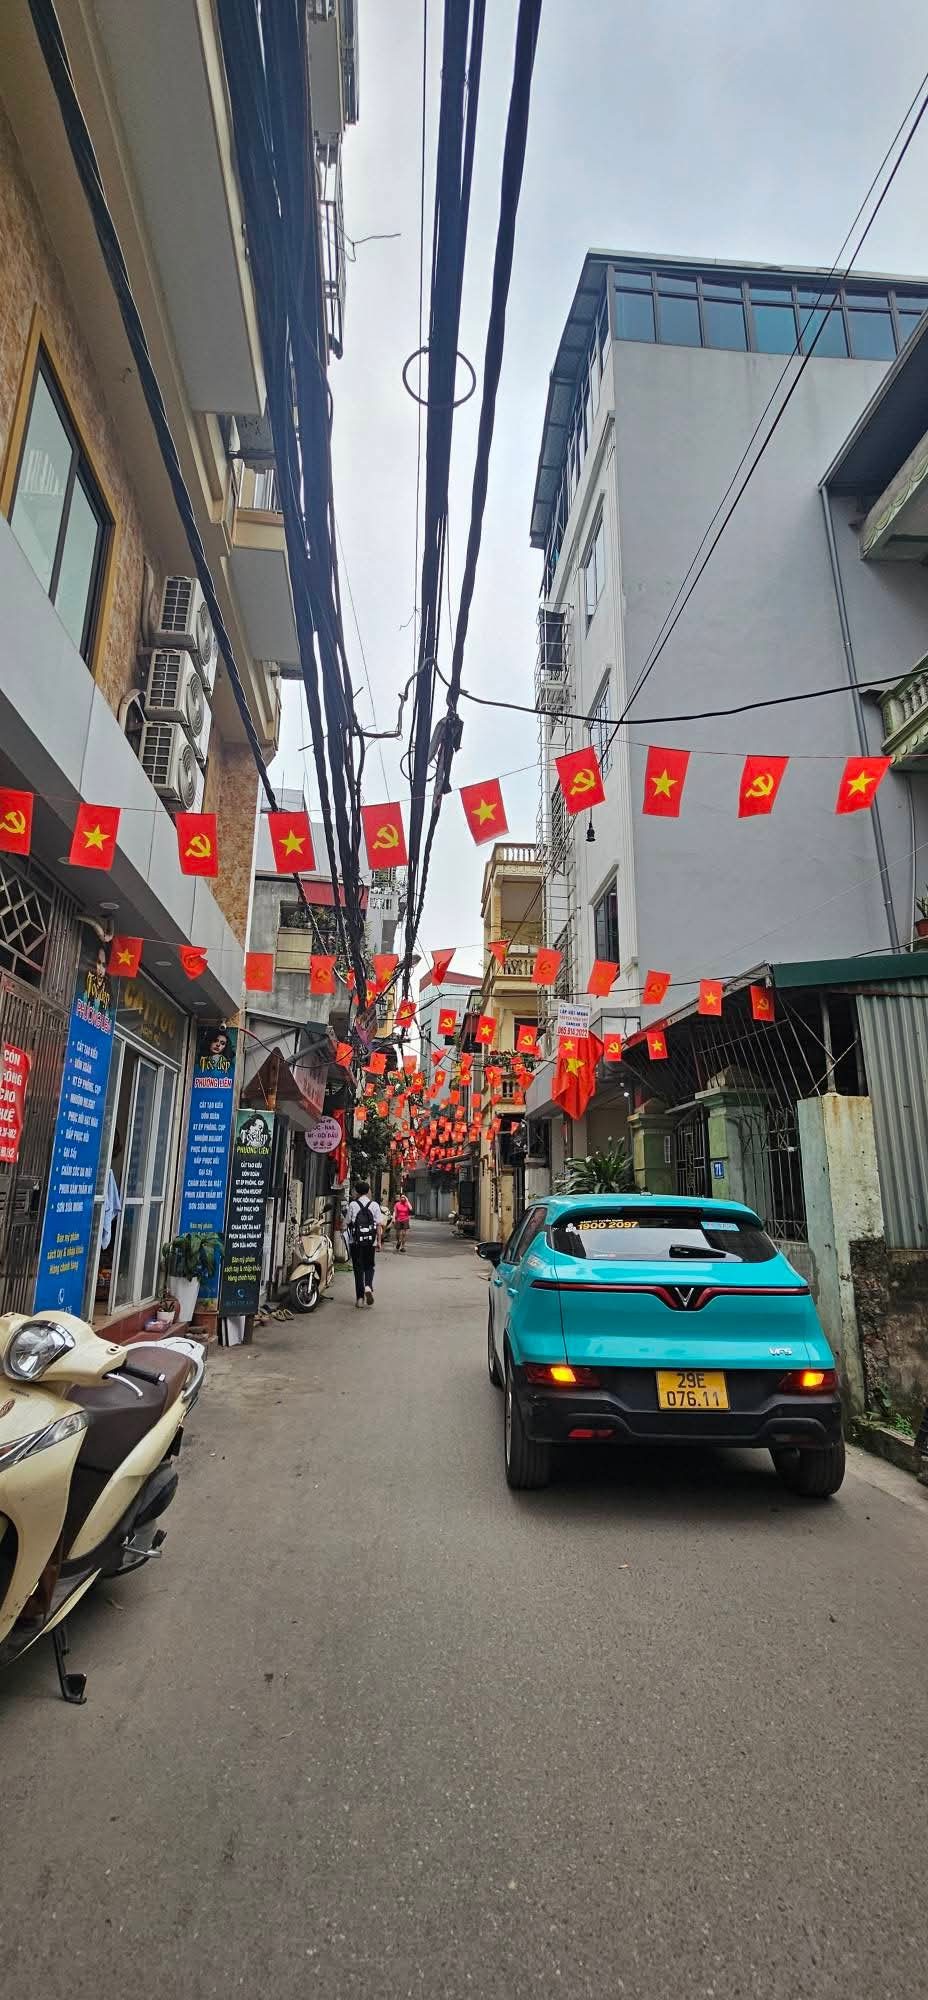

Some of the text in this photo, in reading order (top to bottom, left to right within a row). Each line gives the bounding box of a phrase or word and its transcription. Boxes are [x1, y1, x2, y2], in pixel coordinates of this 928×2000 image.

[578, 1221, 639, 1230] 1900 2097
[677, 1373, 706, 1388] 29E
[667, 1391, 719, 1406] 076.11
